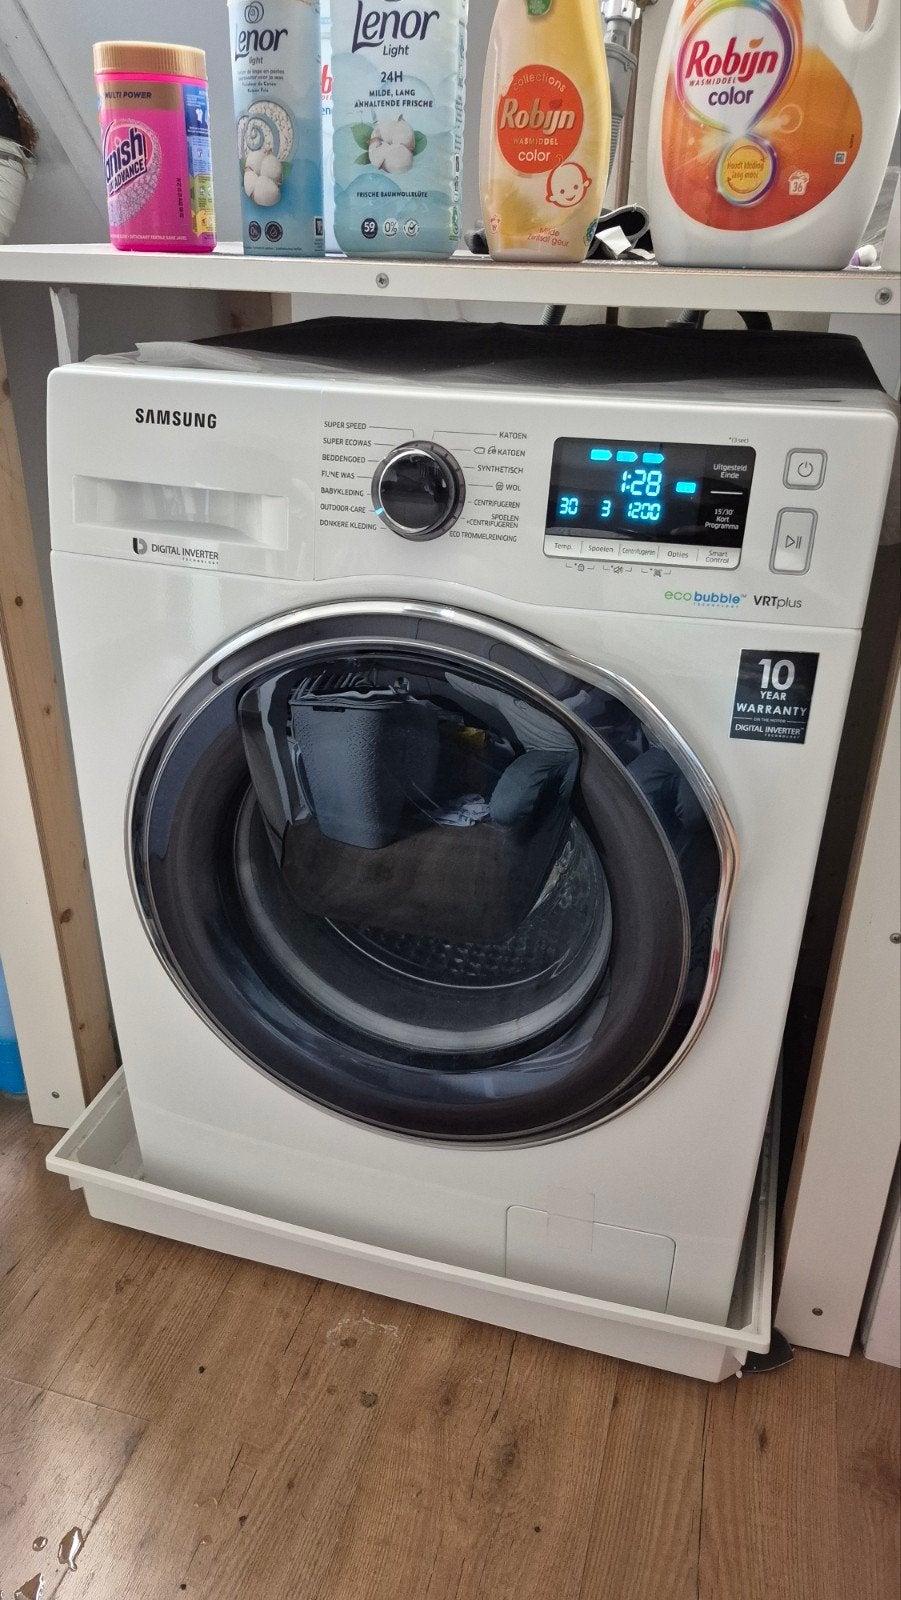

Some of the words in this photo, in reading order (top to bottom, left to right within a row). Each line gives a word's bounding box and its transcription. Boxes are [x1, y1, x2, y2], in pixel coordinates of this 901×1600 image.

[352, 0, 440, 53] Lenor
[383, 44, 409, 57] Light
[685, 37, 778, 83] Robijn
[381, 71, 403, 83] 24H
[688, 76, 737, 86] WASMIDDEL
[513, 73, 566, 93] collections
[105, 91, 122, 99] MULTI
[122, 91, 153, 99] POWER
[369, 89, 394, 98] MILDE,
[395, 89, 416, 97] LANG
[708, 86, 754, 106] color
[354, 99, 400, 108] ANHALTENDE
[402, 99, 433, 108] FRISCHE
[500, 98, 576, 135] Robijn
[513, 137, 559, 146] WASMIDDEL
[518, 149, 551, 162] color
[114, 159, 145, 189] ADVANCE
[792, 181, 803, 193] 36
[364, 221, 376, 233] 59
[384, 221, 397, 233] 0%
[135, 408, 217, 429] SAMSUNG
[324, 421, 345, 429] SUPER
[346, 422, 367, 430] SPEED
[499, 432, 527, 440] KATOEN
[323, 437, 344, 445] SUPER
[345, 438, 372, 447] ECOWAS
[322, 453, 366, 463] BEDDENGOED
[498, 448, 525, 457] KATOEN
[477, 465, 524, 474] SYNTHETISCH
[713, 463, 747, 472] Uitgesteld
[621, 469, 662, 497] 1:28
[321, 487, 364, 496] BABYKLEDING
[474, 499, 520, 508] CENTRIFUGEREN
[559, 497, 579, 515] 30
[601, 500, 611, 517] 3
[627, 502, 661, 520] 1200
[319, 519, 349, 528] DONKERE
[349, 521, 377, 530] KLEDING
[704, 522, 739, 530] Programma
[461, 531, 517, 542] TROMMELREINIGING
[151, 543, 180, 555] DIGITAL
[182, 548, 219, 560] INVERTER
[588, 545, 613, 553] Spoelen
[622, 547, 656, 556] Centrifugeren
[667, 550, 689, 559] Opties
[708, 549, 728, 557] Smart
[705, 556, 729, 564] Control
[753, 595, 802, 609] VRTplus
[758, 658, 796, 691] 10
[760, 691, 787, 701] YEAR
[736, 702, 807, 716] WARRANTY
[735, 723, 764, 733] DIGITAL
[765, 726, 801, 735] INVERTER
